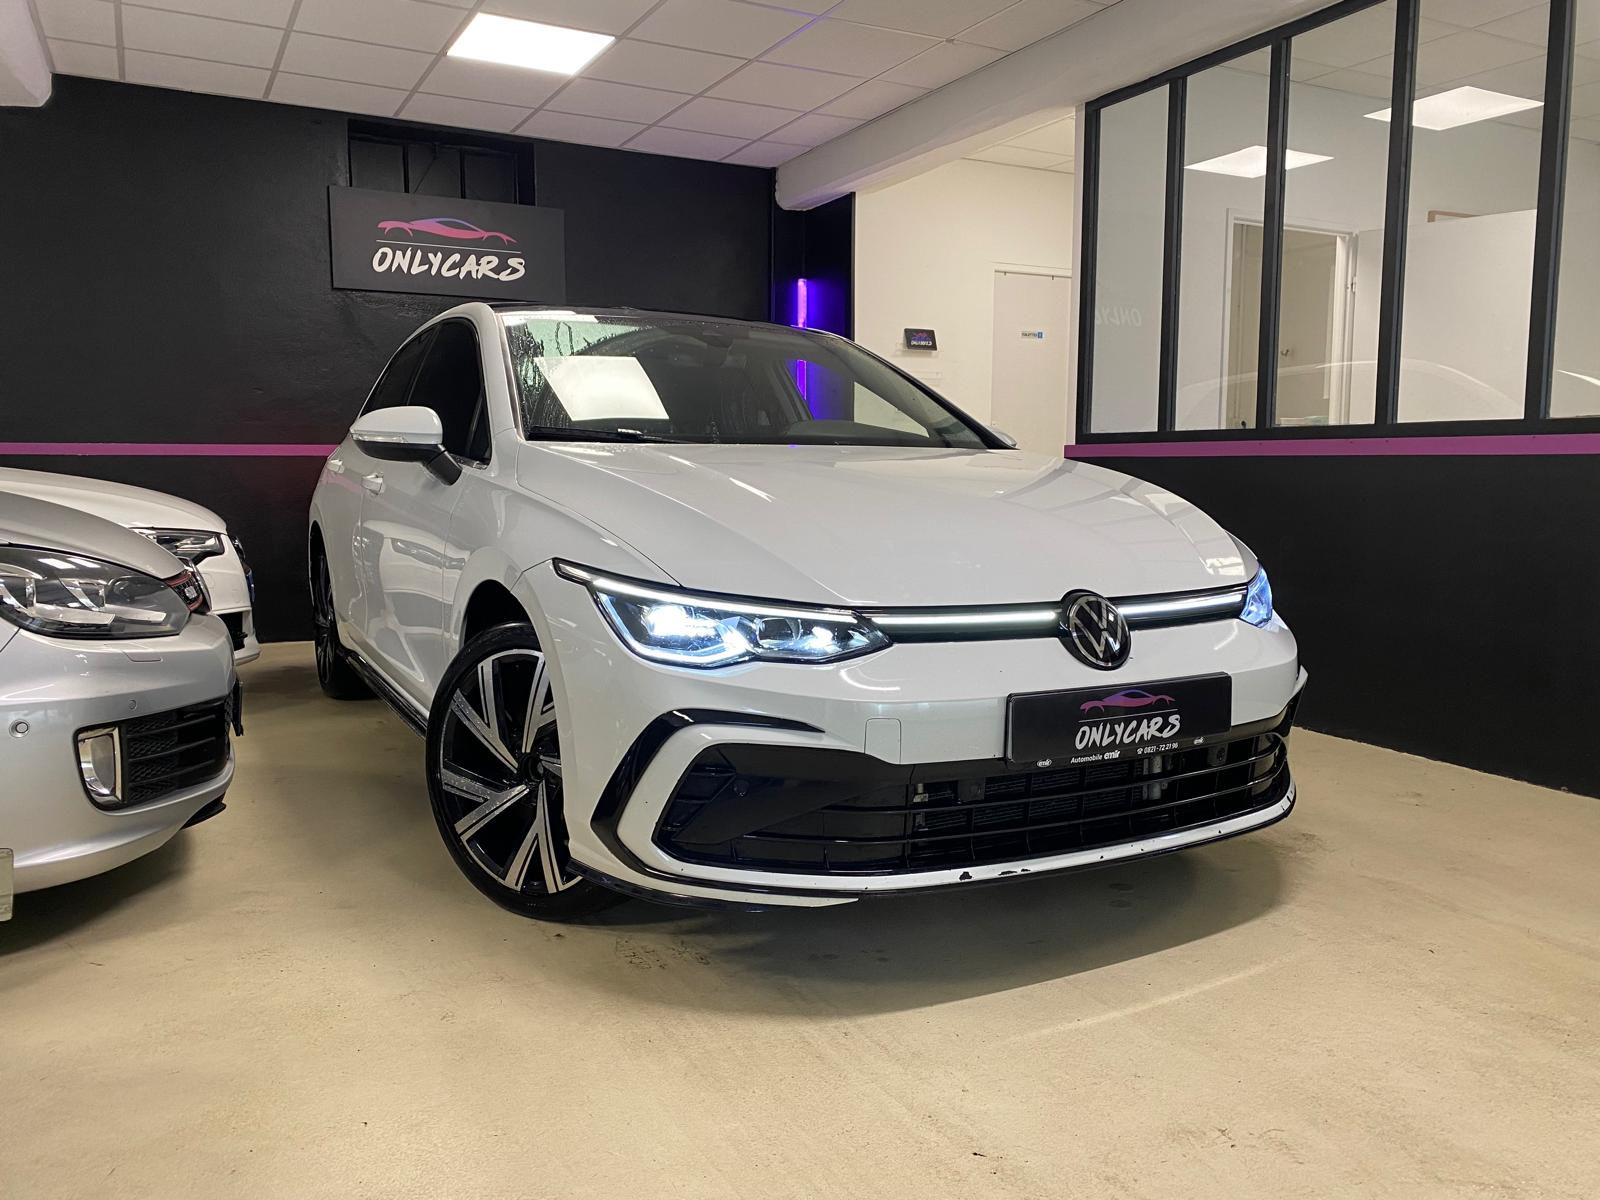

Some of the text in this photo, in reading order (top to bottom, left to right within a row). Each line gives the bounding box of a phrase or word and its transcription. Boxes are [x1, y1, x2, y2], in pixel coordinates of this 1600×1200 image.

[372, 246, 526, 281] ONLYCARS
[1075, 714, 1180, 750] ONLYCARS
[1070, 753, 1103, 764] Automobile
